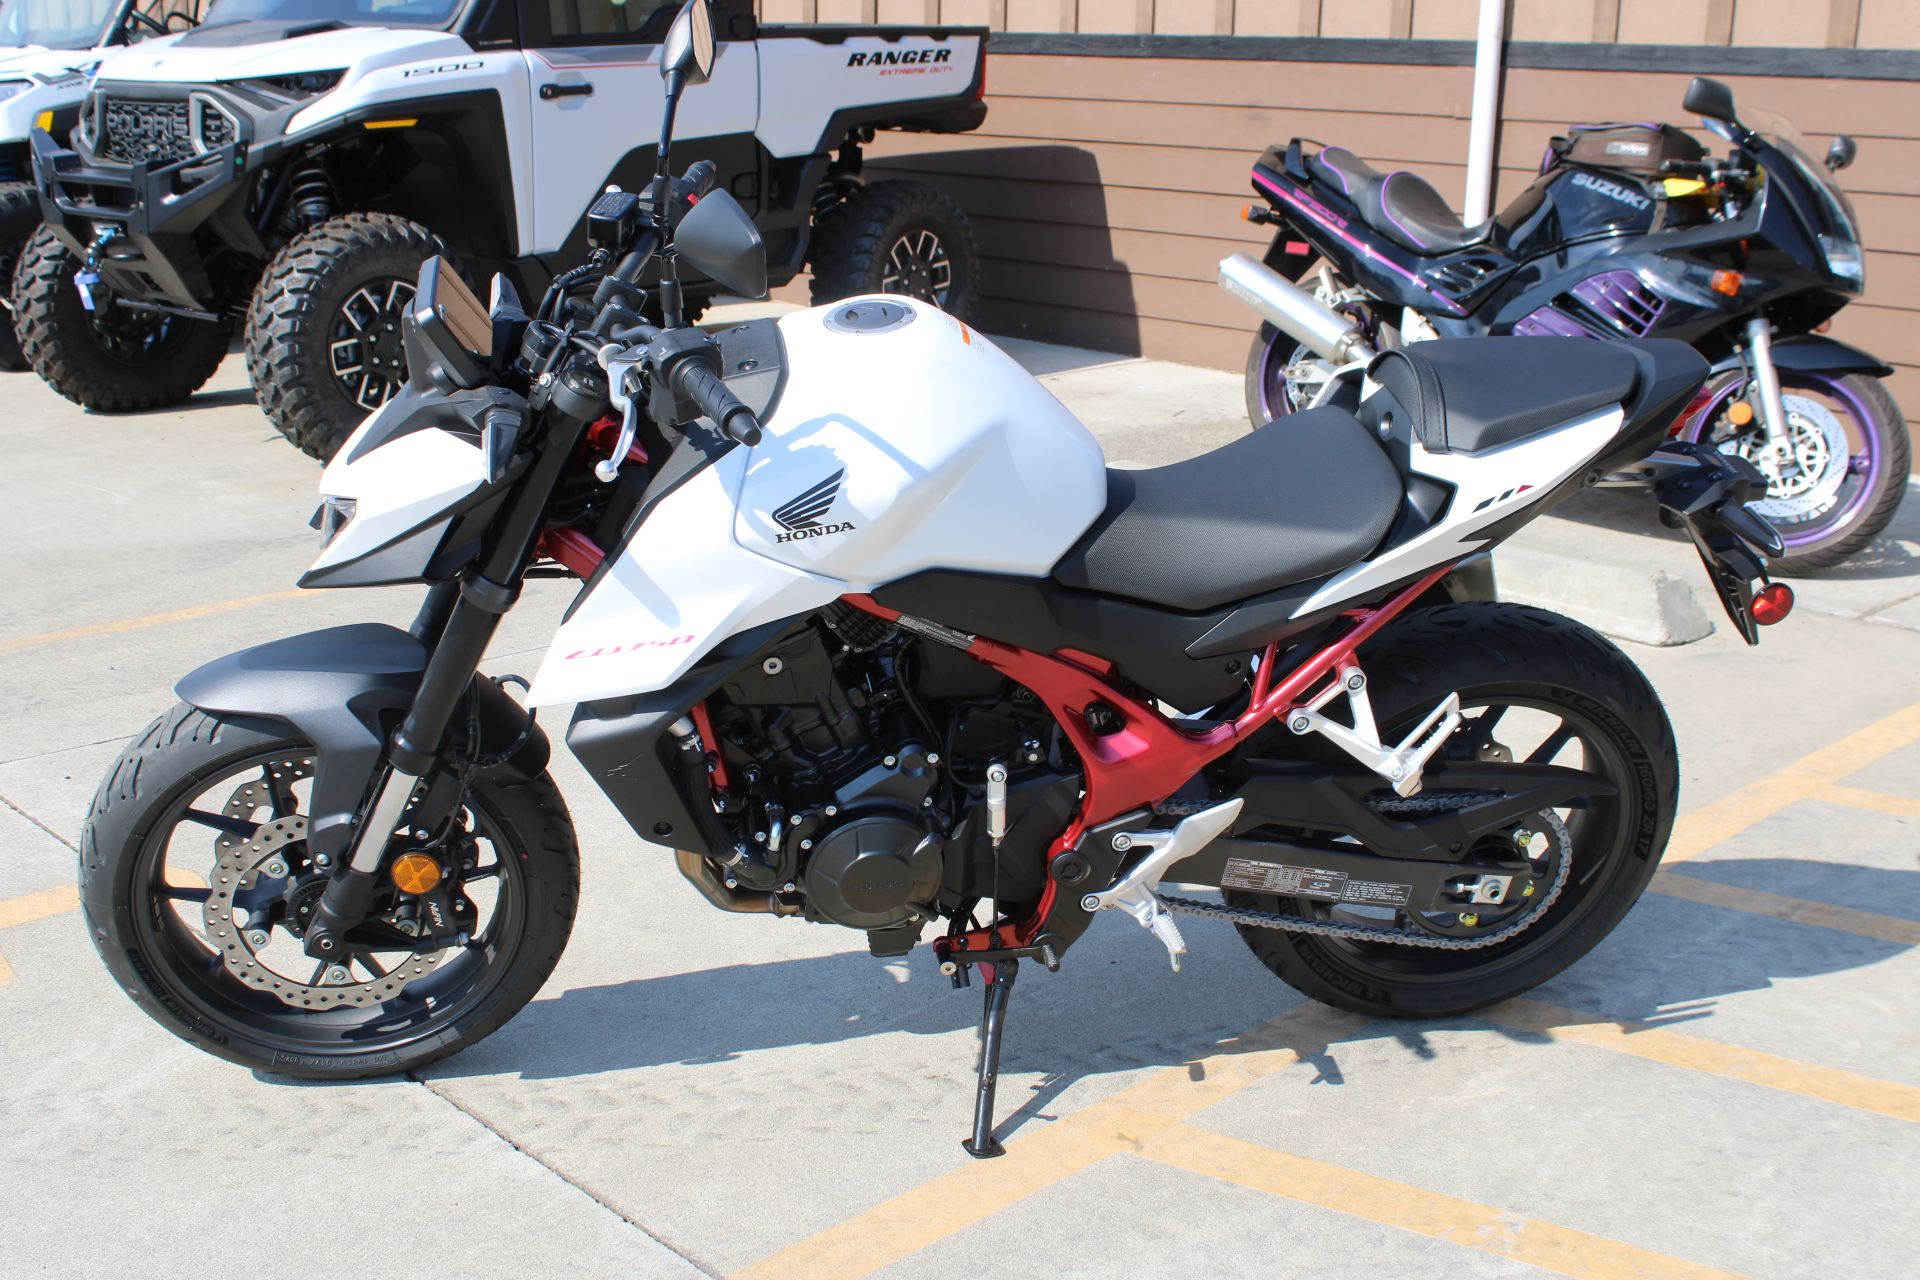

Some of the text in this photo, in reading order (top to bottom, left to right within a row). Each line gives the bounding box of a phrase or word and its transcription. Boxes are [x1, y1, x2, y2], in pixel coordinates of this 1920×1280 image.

[402, 61, 484, 77] 1500
[847, 48, 952, 67] RANGER
[879, 66, 954, 76] EXTREME DUTY
[106, 112, 189, 137] POLARIS
[1571, 172, 1651, 210] SUZUKI
[775, 521, 857, 544] HONDA
[1579, 697, 1657, 858] MICHELIN 160/60 ZR 17
